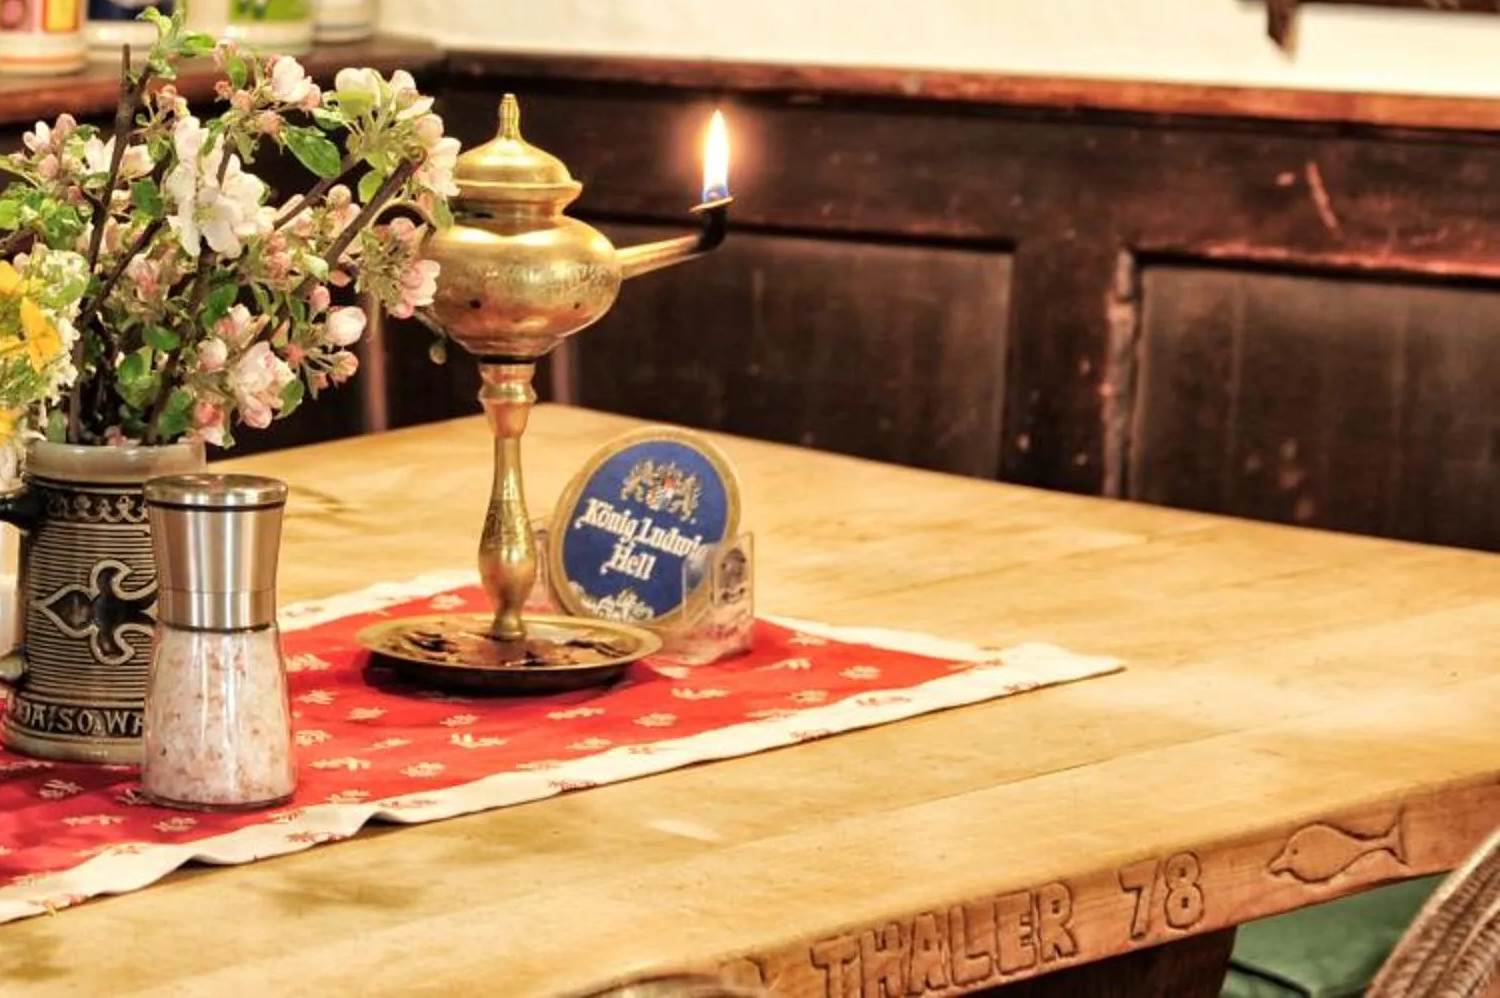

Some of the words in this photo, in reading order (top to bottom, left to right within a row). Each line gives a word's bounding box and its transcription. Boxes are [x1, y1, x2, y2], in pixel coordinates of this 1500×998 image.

[574, 498, 638, 543] König
[636, 518, 709, 559] Ludwig
[600, 543, 657, 581] Hell
[809, 881, 1078, 998] THALER
[1119, 850, 1206, 942] 78
